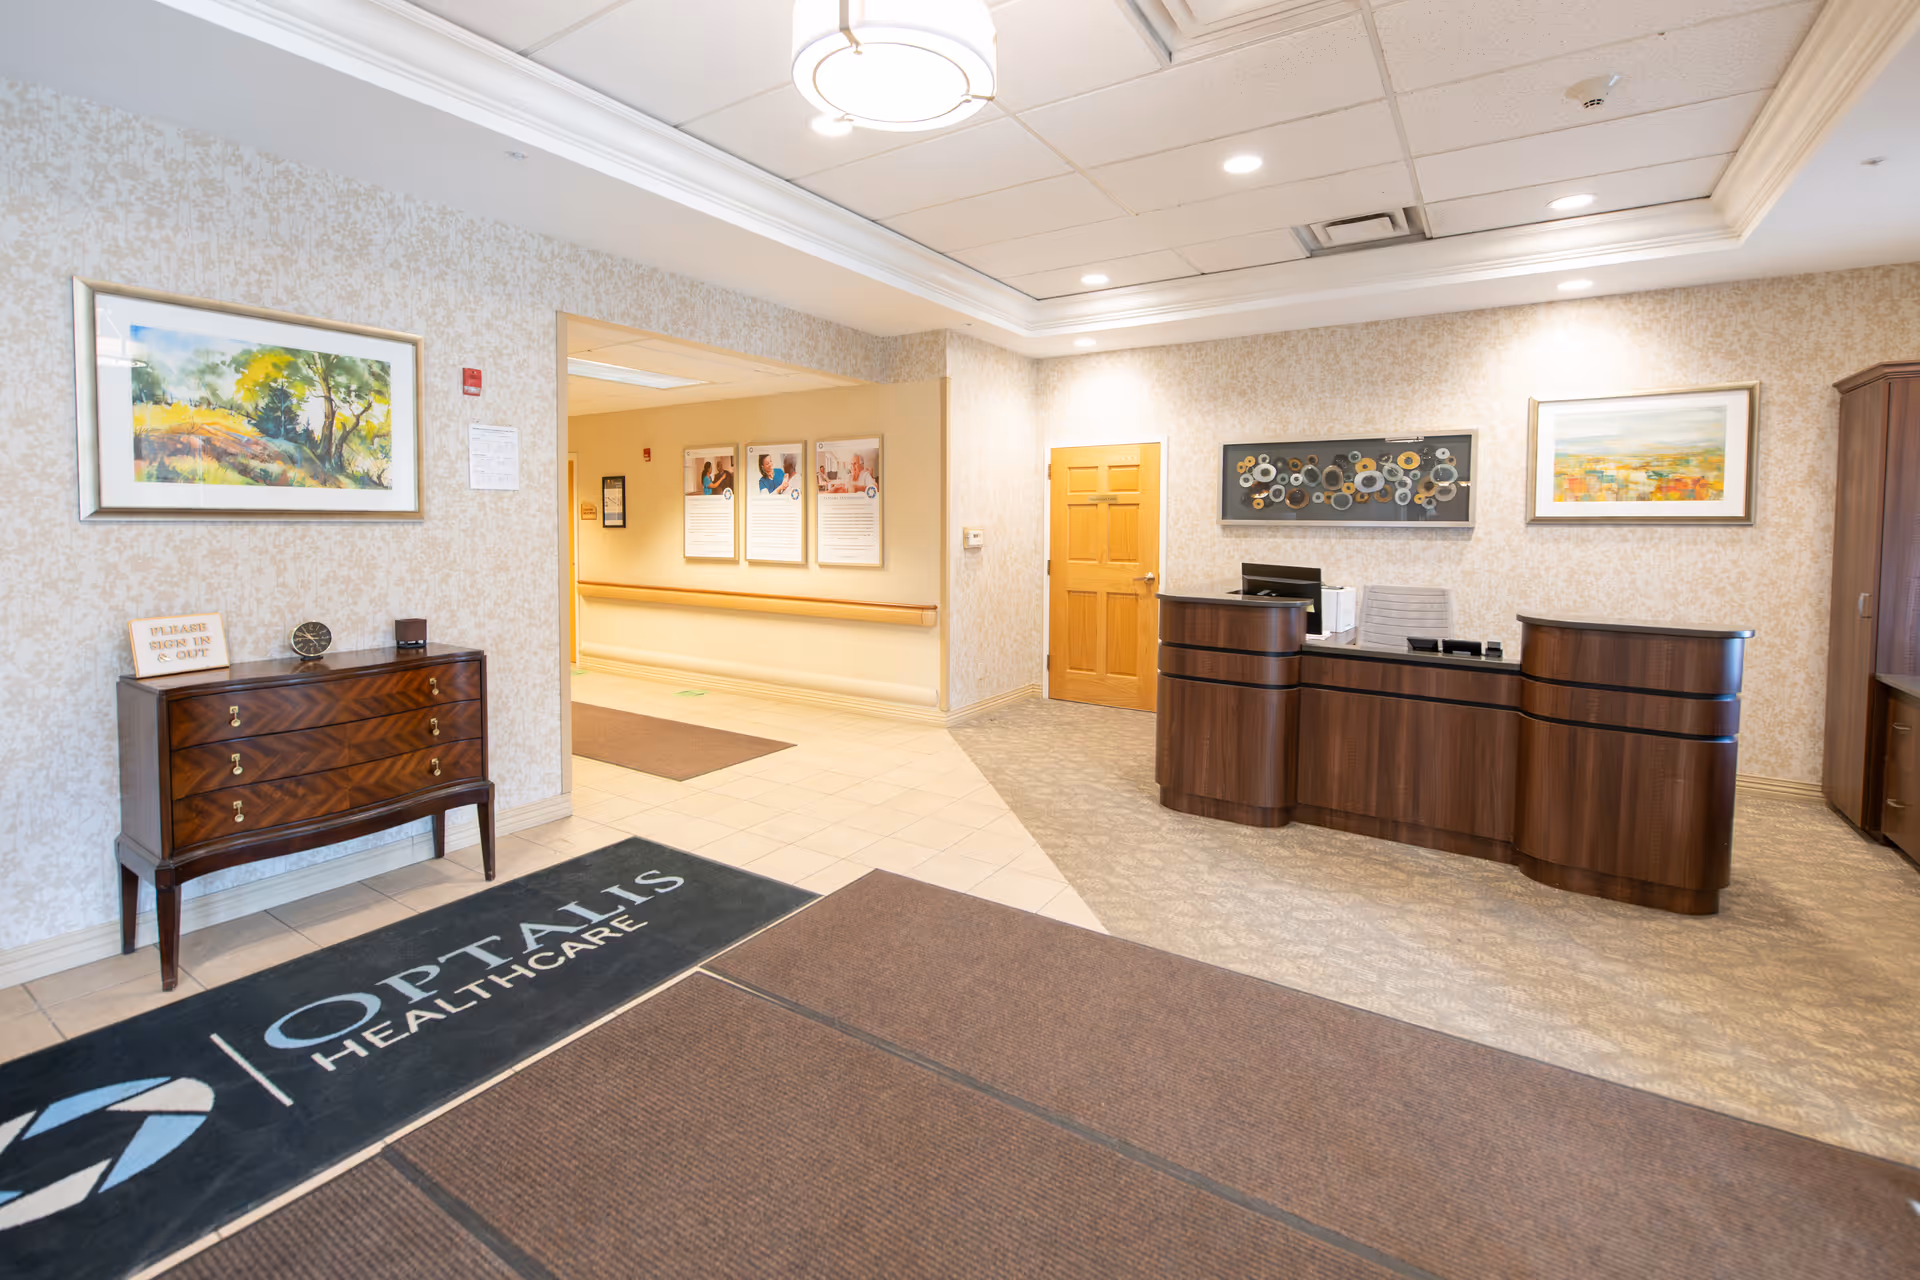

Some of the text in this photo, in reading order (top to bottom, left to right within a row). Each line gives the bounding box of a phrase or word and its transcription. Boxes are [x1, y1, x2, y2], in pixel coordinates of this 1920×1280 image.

[150, 622, 206, 636] PLEASE
[149, 635, 211, 650] SIGN IN
[158, 648, 209, 662] & OUT
[264, 869, 685, 1049] OPTALIS
[311, 914, 648, 1072] HEALTHCARE
